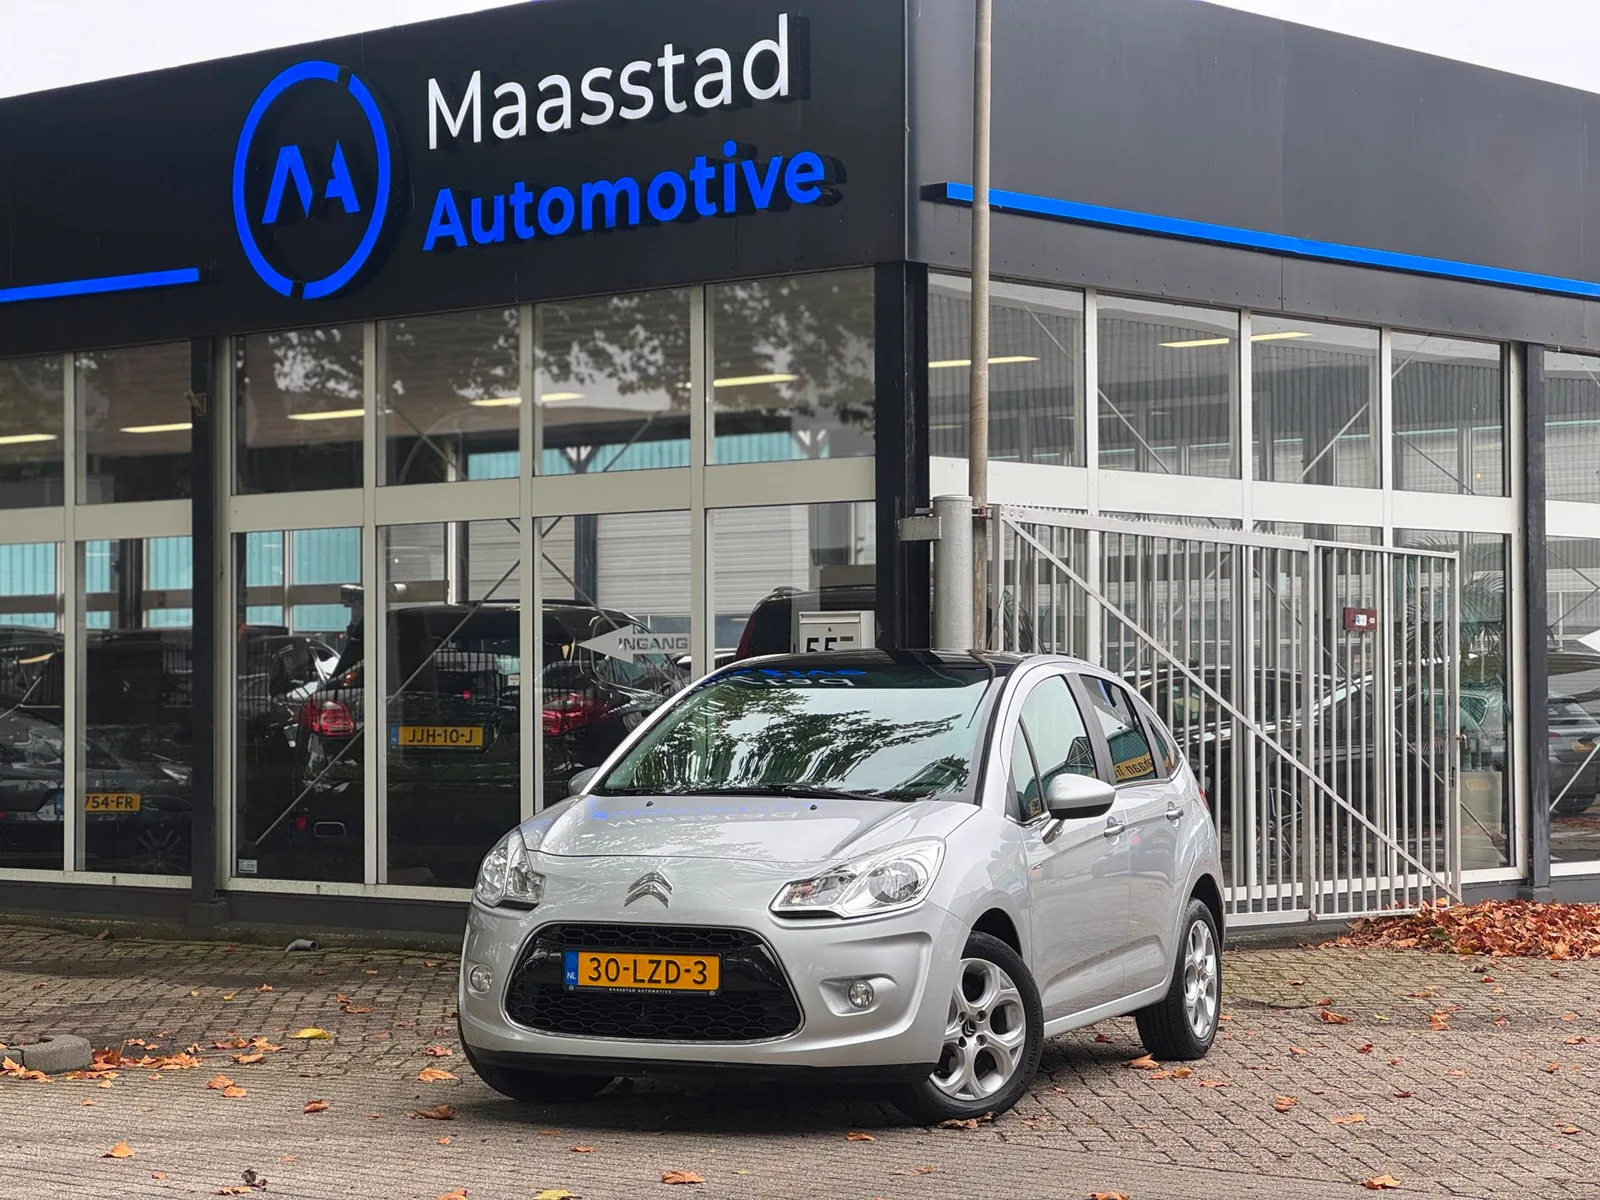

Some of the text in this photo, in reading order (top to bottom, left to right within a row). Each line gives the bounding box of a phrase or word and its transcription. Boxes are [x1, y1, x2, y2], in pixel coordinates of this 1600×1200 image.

[428, 13, 789, 149] Maasstad
[422, 140, 825, 252] Automotive
[619, 637, 688, 651] INGANG
[408, 728, 473, 743] JJH-10-J
[85, 795, 133, 809] 754-FR
[566, 956, 707, 985] NL 30-LZD-3
